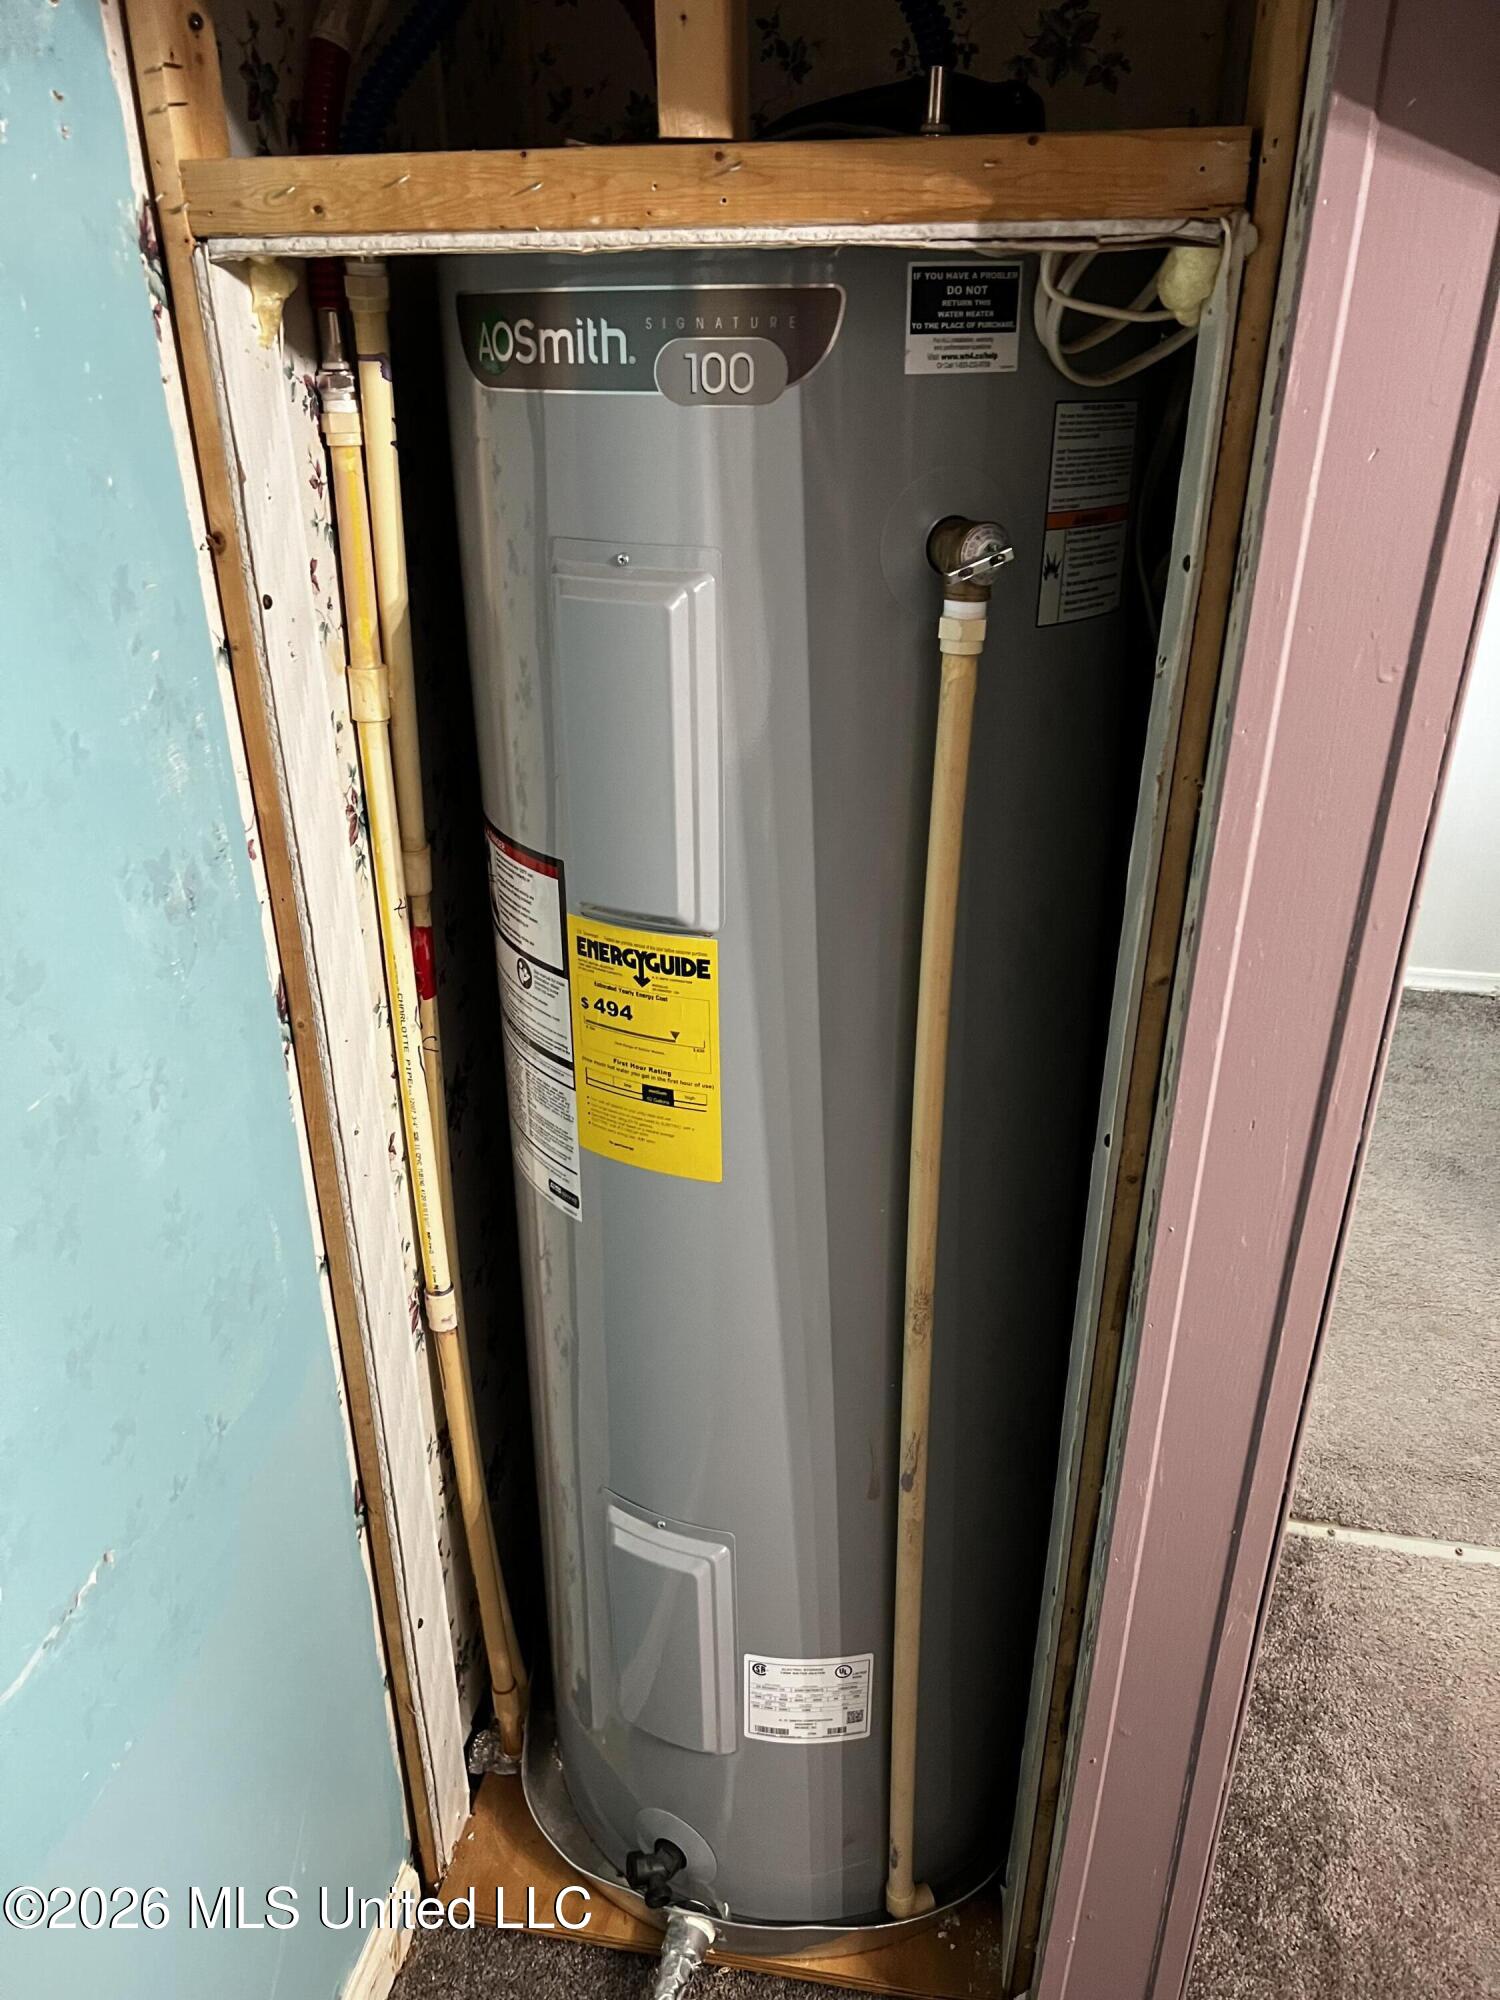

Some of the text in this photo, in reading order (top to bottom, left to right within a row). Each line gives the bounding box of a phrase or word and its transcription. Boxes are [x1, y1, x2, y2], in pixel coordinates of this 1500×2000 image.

[913, 272, 921, 280] IF
[925, 272, 943, 280] YOU
[946, 271, 969, 279] HAVE
[972, 271, 978, 279] A
[947, 285, 988, 295] DO NOT
[645, 316, 797, 329] SIGNATURE
[684, 352, 755, 394] 100
[576, 935, 711, 980] ENERGYGUIDE
[636, 991, 654, 1001] Energy
[594, 997, 633, 1021] 494
[397, 992, 410, 1053] CHARLOTTE
[613, 1058, 672, 1077] First Hour Rating
